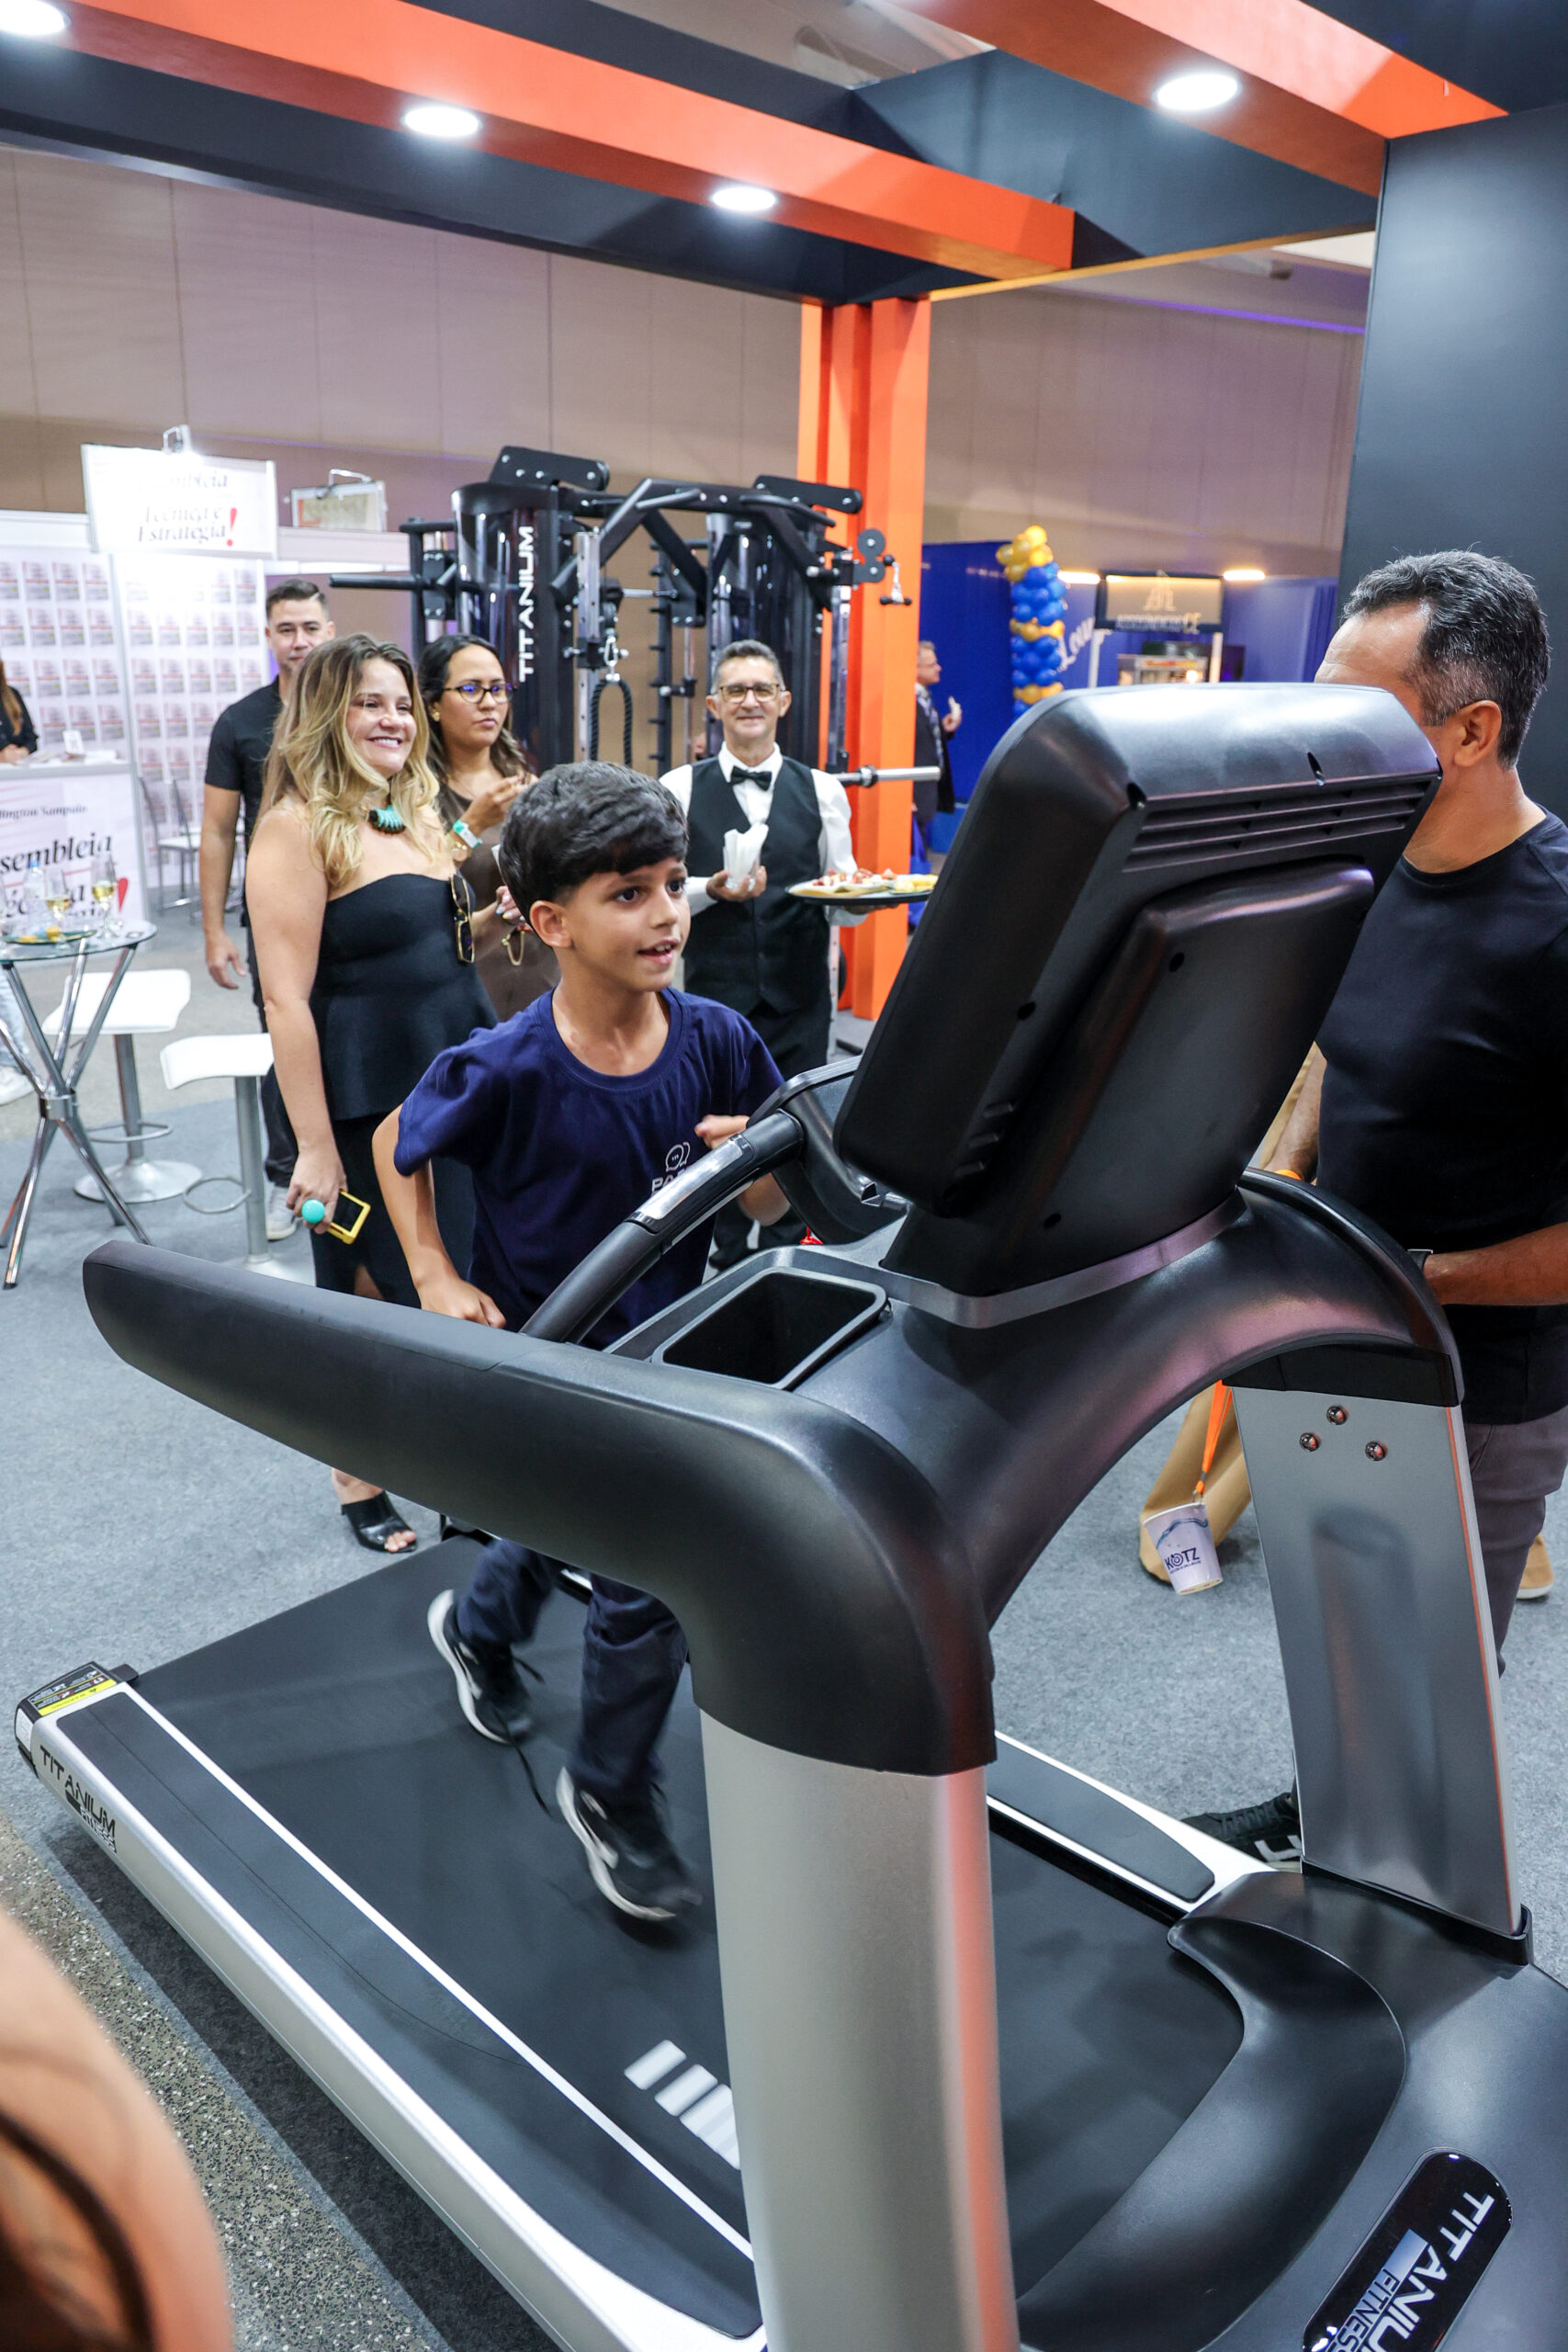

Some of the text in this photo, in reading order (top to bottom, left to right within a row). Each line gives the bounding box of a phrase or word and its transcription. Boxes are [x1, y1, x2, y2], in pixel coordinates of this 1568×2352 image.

[518, 526, 534, 683] TITANIUM
[1165, 1547, 1200, 1570] KOTZ
[40, 1745, 116, 1838] TITANIUM
[1358, 2191, 1495, 2352] TITANIU
